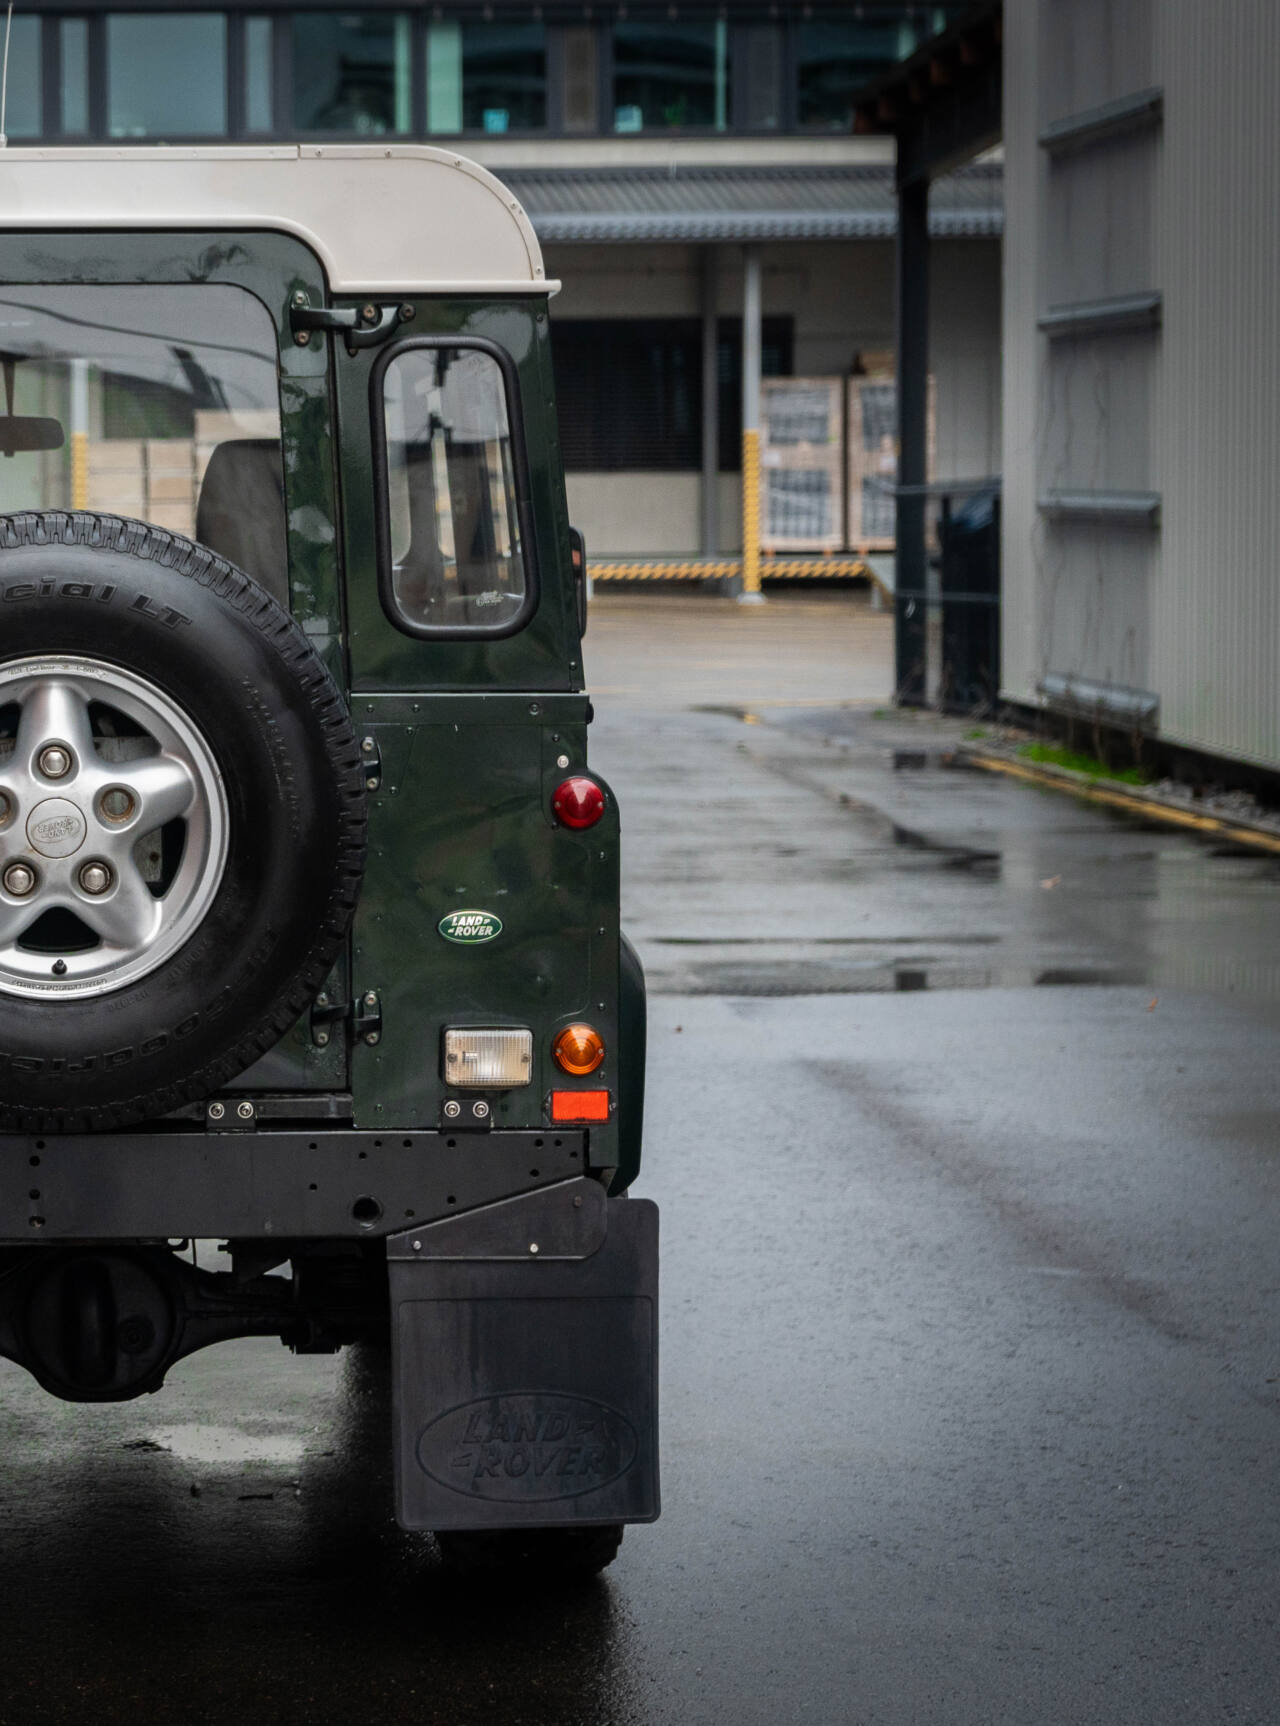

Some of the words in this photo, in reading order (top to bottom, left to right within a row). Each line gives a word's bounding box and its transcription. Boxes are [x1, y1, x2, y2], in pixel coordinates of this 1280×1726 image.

[126, 592, 193, 630] LT
[451, 916, 483, 926] LAND
[454, 925, 493, 936] ROVER
[462, 1411, 570, 1443] LAND
[471, 1447, 608, 1478] ROVER
